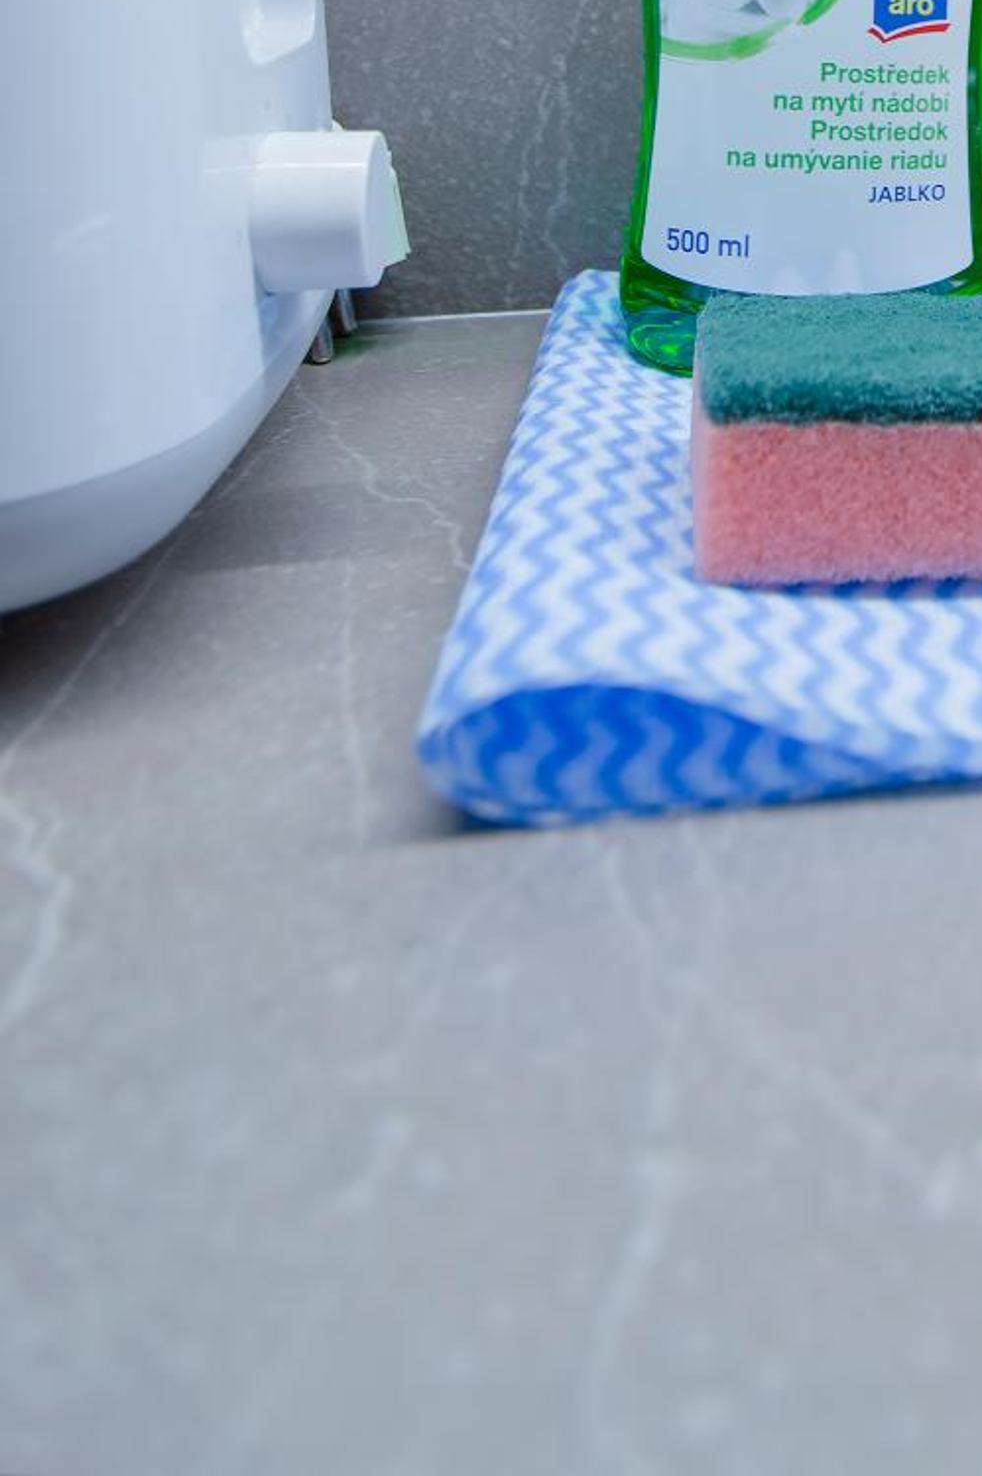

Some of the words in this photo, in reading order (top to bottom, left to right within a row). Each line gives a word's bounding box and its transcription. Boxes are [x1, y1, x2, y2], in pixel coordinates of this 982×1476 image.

[820, 62, 950, 85] Prostředek
[773, 93, 803, 111] na
[811, 119, 948, 141] Prostriedok
[727, 150, 756, 168] na
[765, 149, 882, 174] umývanie
[891, 149, 948, 171] riadu
[868, 184, 946, 204] JABLKO
[666, 228, 709, 254] 500
[718, 234, 750, 258] ml
